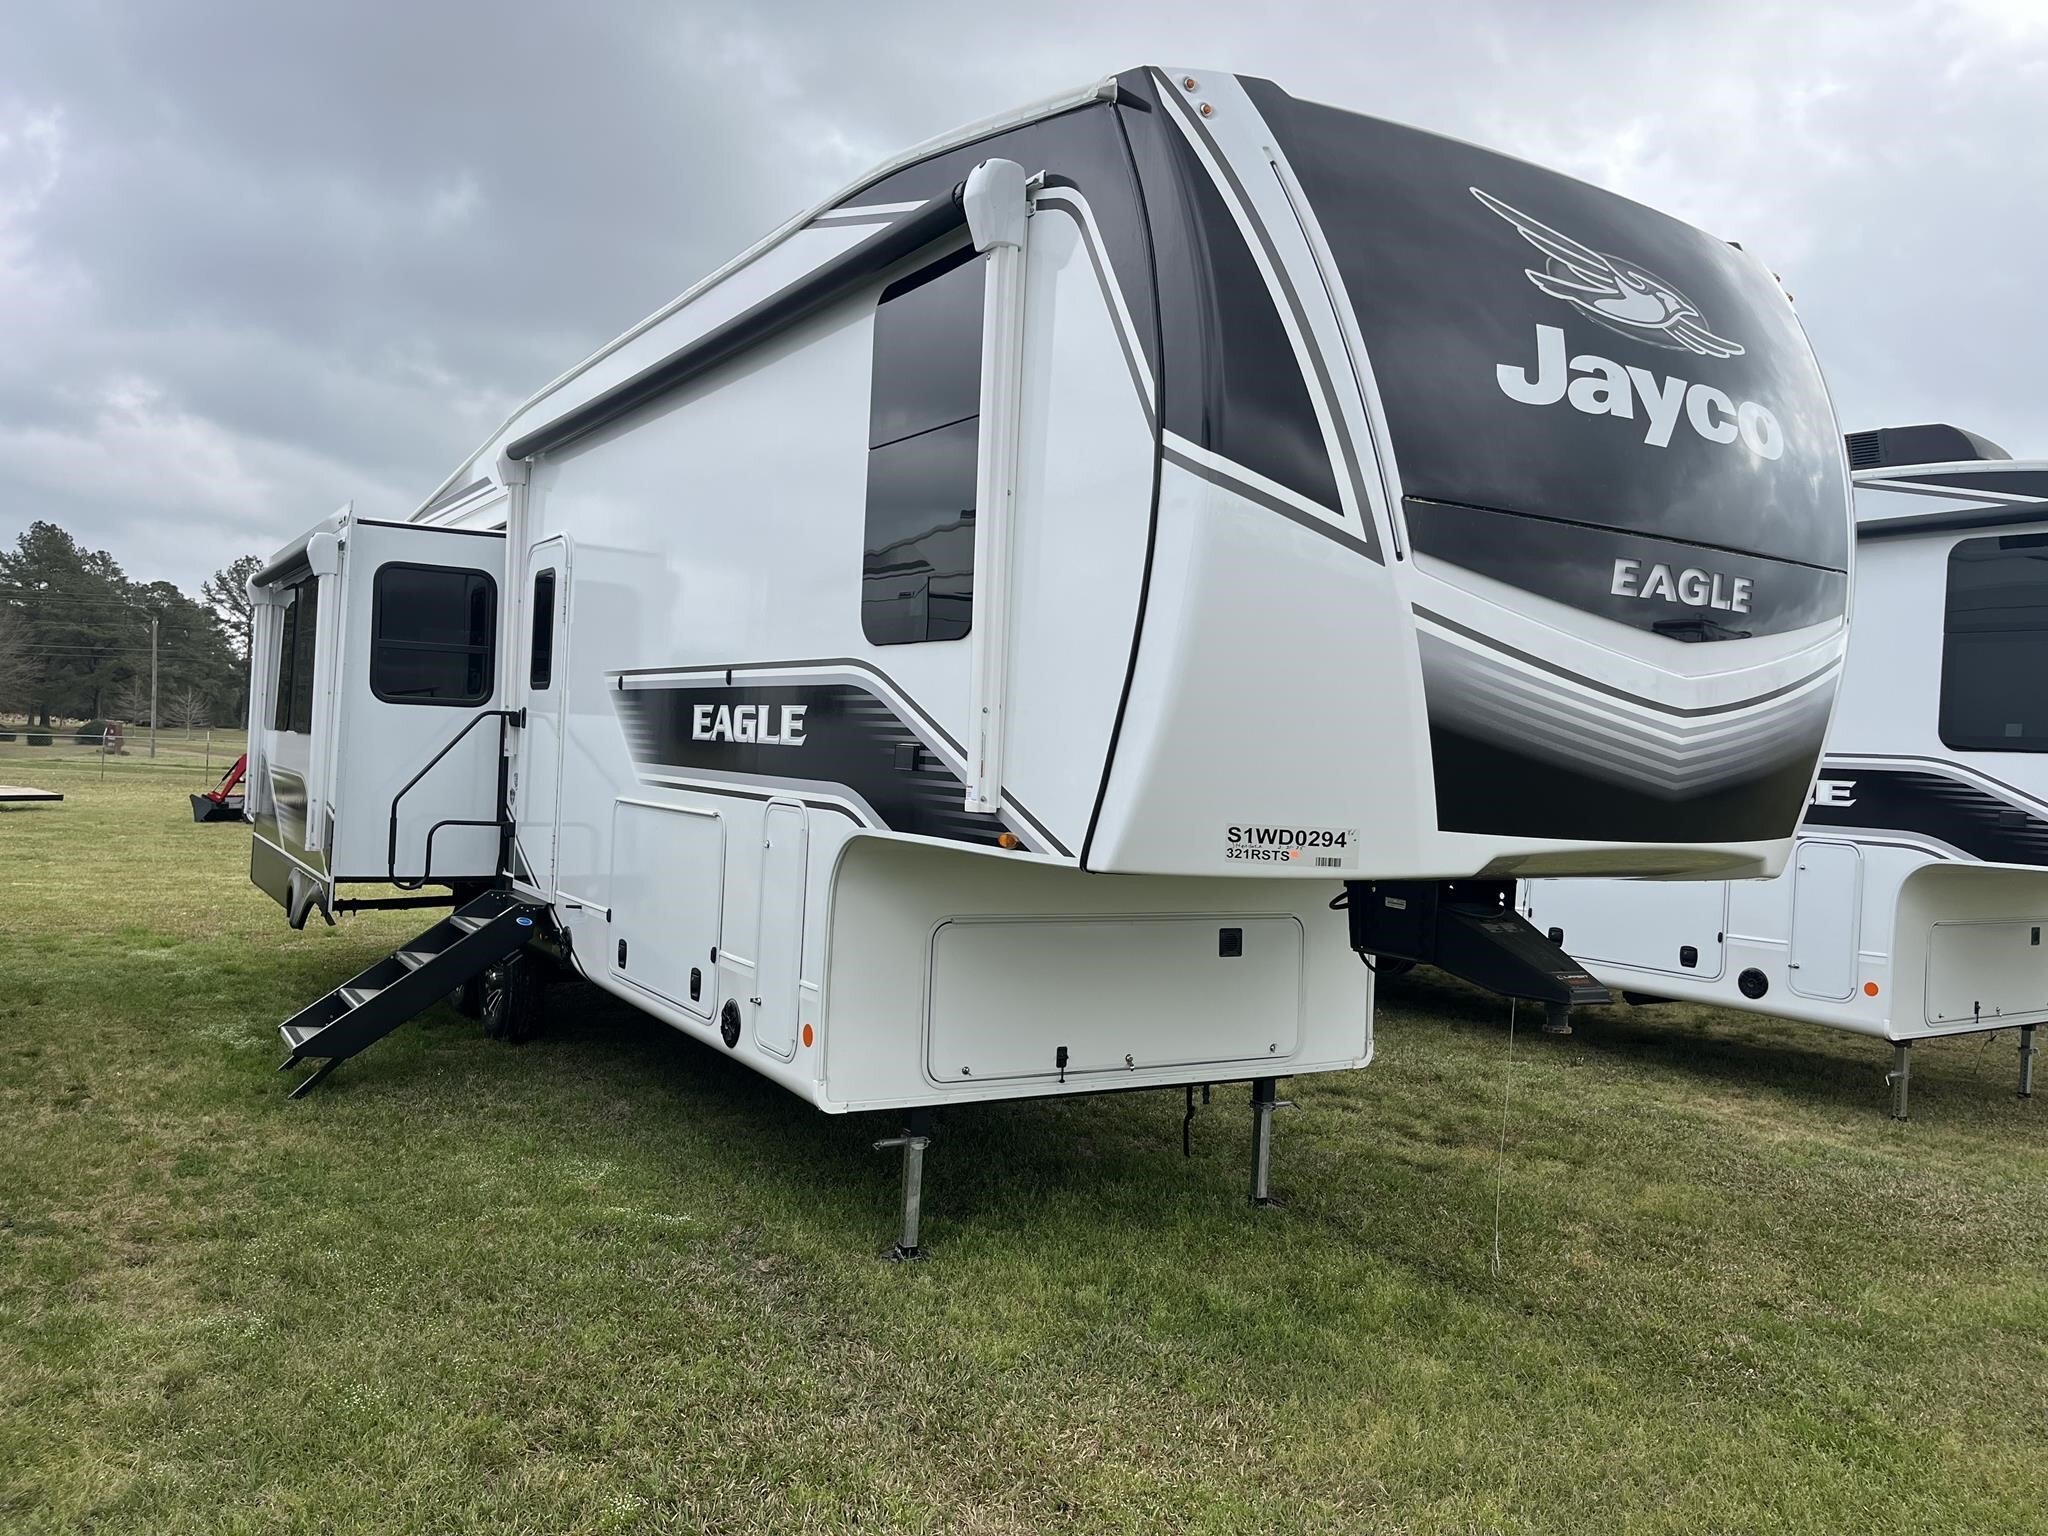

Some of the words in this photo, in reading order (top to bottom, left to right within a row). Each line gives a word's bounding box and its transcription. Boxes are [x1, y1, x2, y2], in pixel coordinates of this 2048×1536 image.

[1496, 323, 1784, 461] Jayco
[1610, 558, 1755, 614] EAGLE
[692, 704, 809, 746] EAGLE
[1226, 848, 1290, 861] 321RSTS
[1227, 826, 1347, 848] S1WD0294
